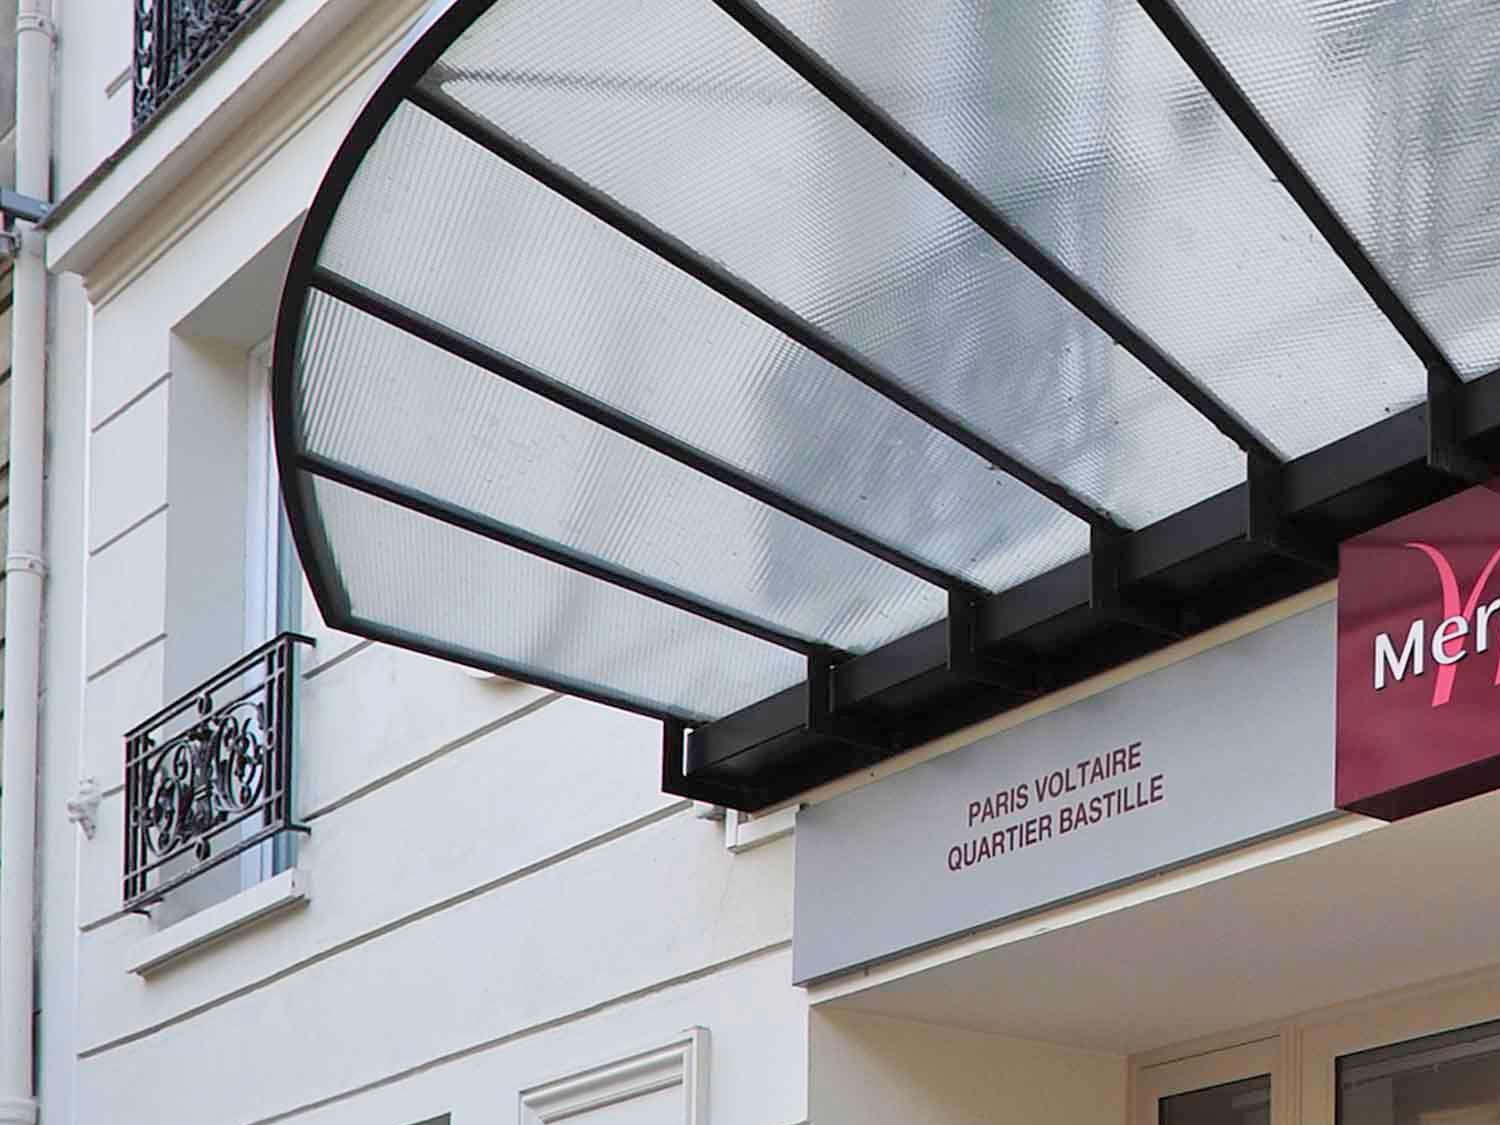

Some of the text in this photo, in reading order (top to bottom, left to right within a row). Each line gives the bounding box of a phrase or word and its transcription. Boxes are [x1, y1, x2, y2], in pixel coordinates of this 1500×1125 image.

[947, 774, 1165, 872] QUARTIER BASTILLE
[968, 741, 1143, 828] PARIS VOLTAIRE
